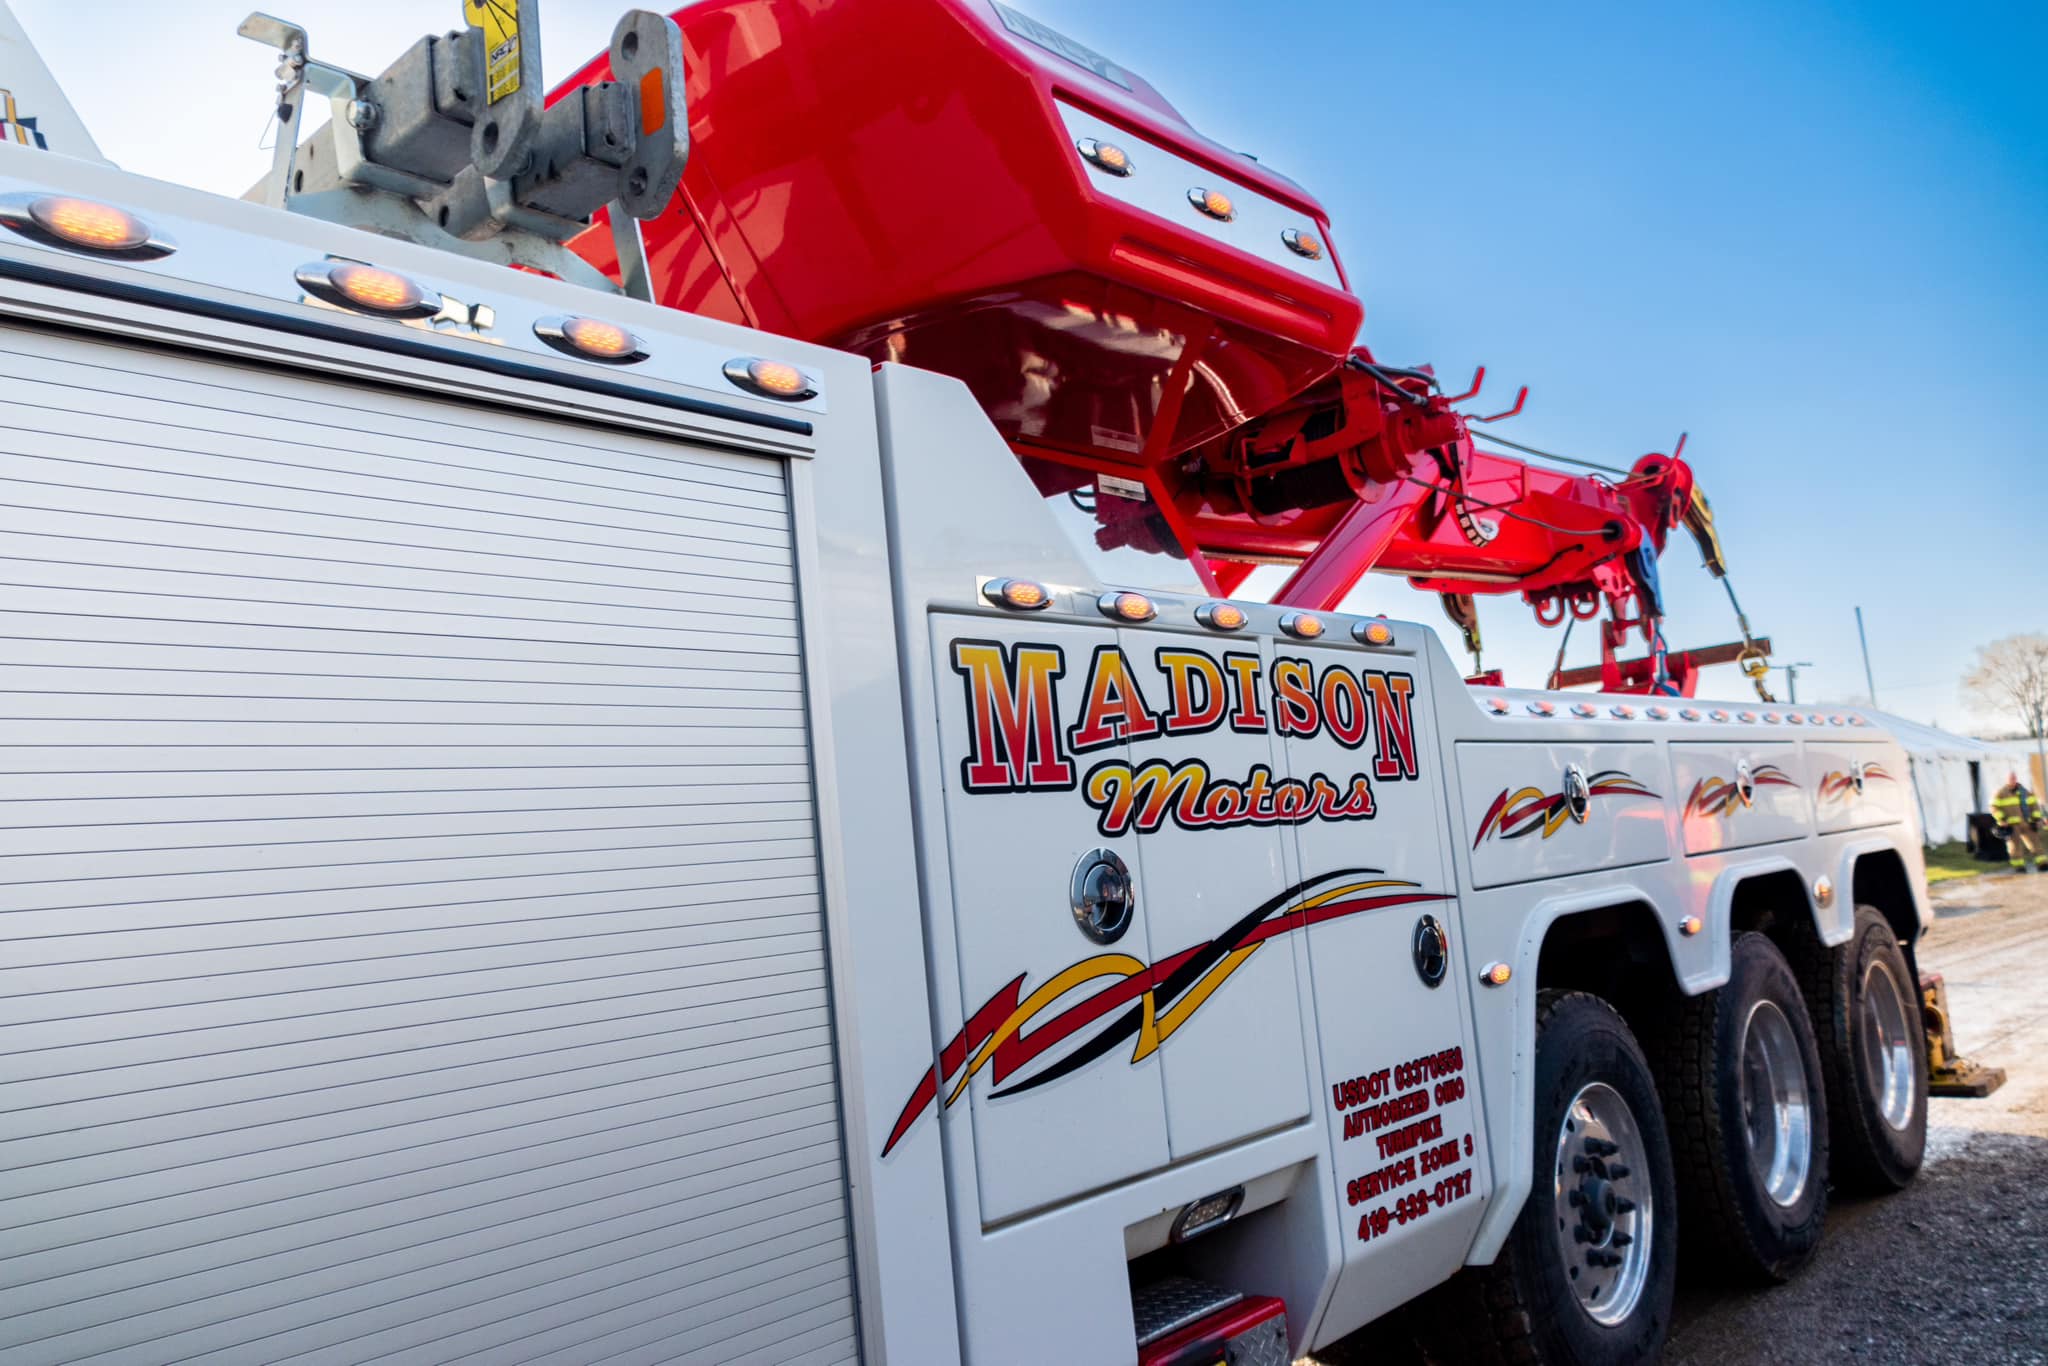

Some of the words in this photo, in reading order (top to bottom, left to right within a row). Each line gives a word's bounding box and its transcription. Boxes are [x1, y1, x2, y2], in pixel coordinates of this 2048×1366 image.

[950, 638, 1419, 793] MADISON
[1082, 758, 1376, 836] Motors
[1332, 1068, 1391, 1112] USDOT
[1343, 1089, 1430, 1141] AUTHORIZED
[1435, 1077, 1465, 1106] OHIO
[1347, 1156, 1417, 1206] SERVICE
[1420, 1139, 1460, 1176] ZONE
[1464, 1133, 1473, 1157] 3
[1376, 1114, 1443, 1160] TURNPIKE
[1358, 1168, 1472, 1242] 419-332-0727
